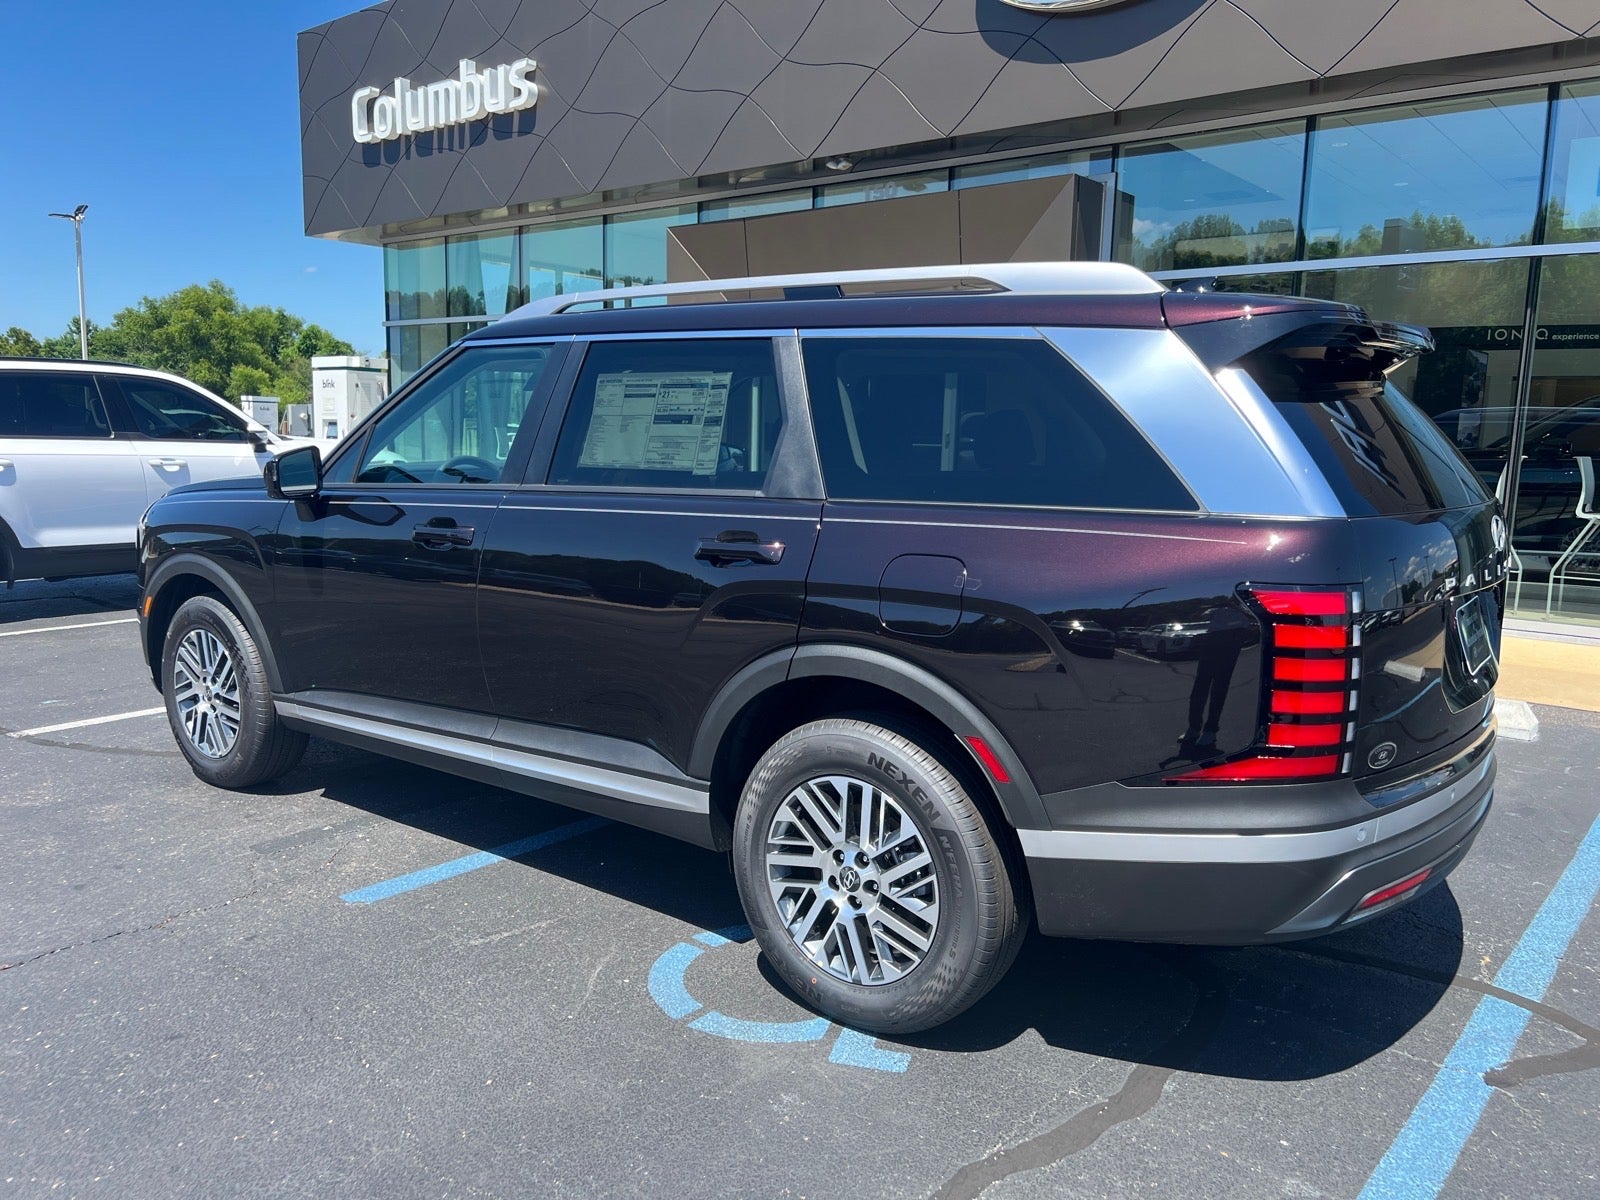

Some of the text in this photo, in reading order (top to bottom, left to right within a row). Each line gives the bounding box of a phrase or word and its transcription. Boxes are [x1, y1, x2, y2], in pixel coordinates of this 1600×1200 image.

[352, 58, 538, 144] Columbus
[1487, 328, 1600, 342] IONQ experience
[322, 379, 336, 389] blink
[867, 752, 942, 822] NEXEN
